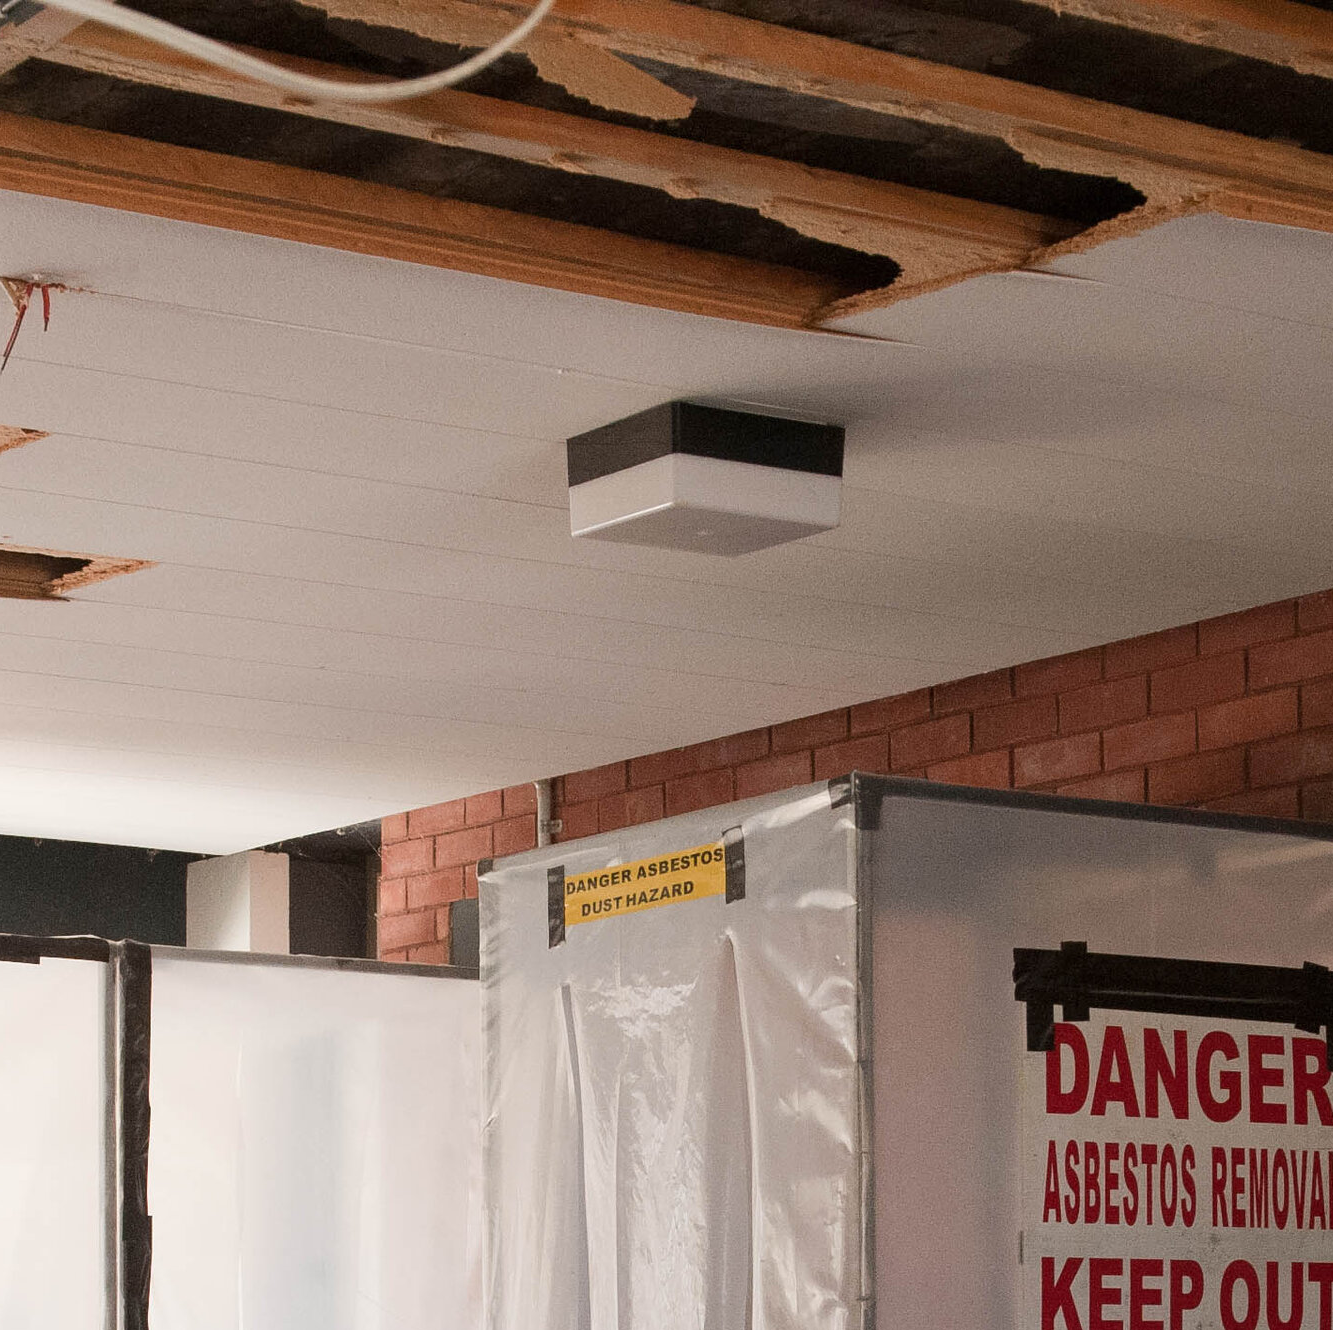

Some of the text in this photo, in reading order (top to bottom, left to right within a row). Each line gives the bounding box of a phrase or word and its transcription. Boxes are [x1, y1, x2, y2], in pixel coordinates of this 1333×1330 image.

[567, 848, 724, 895] DANGER ASBESTOS
[582, 881, 694, 917] DUST HAZARD
[1042, 1139, 1197, 1228] ASBESTOS
